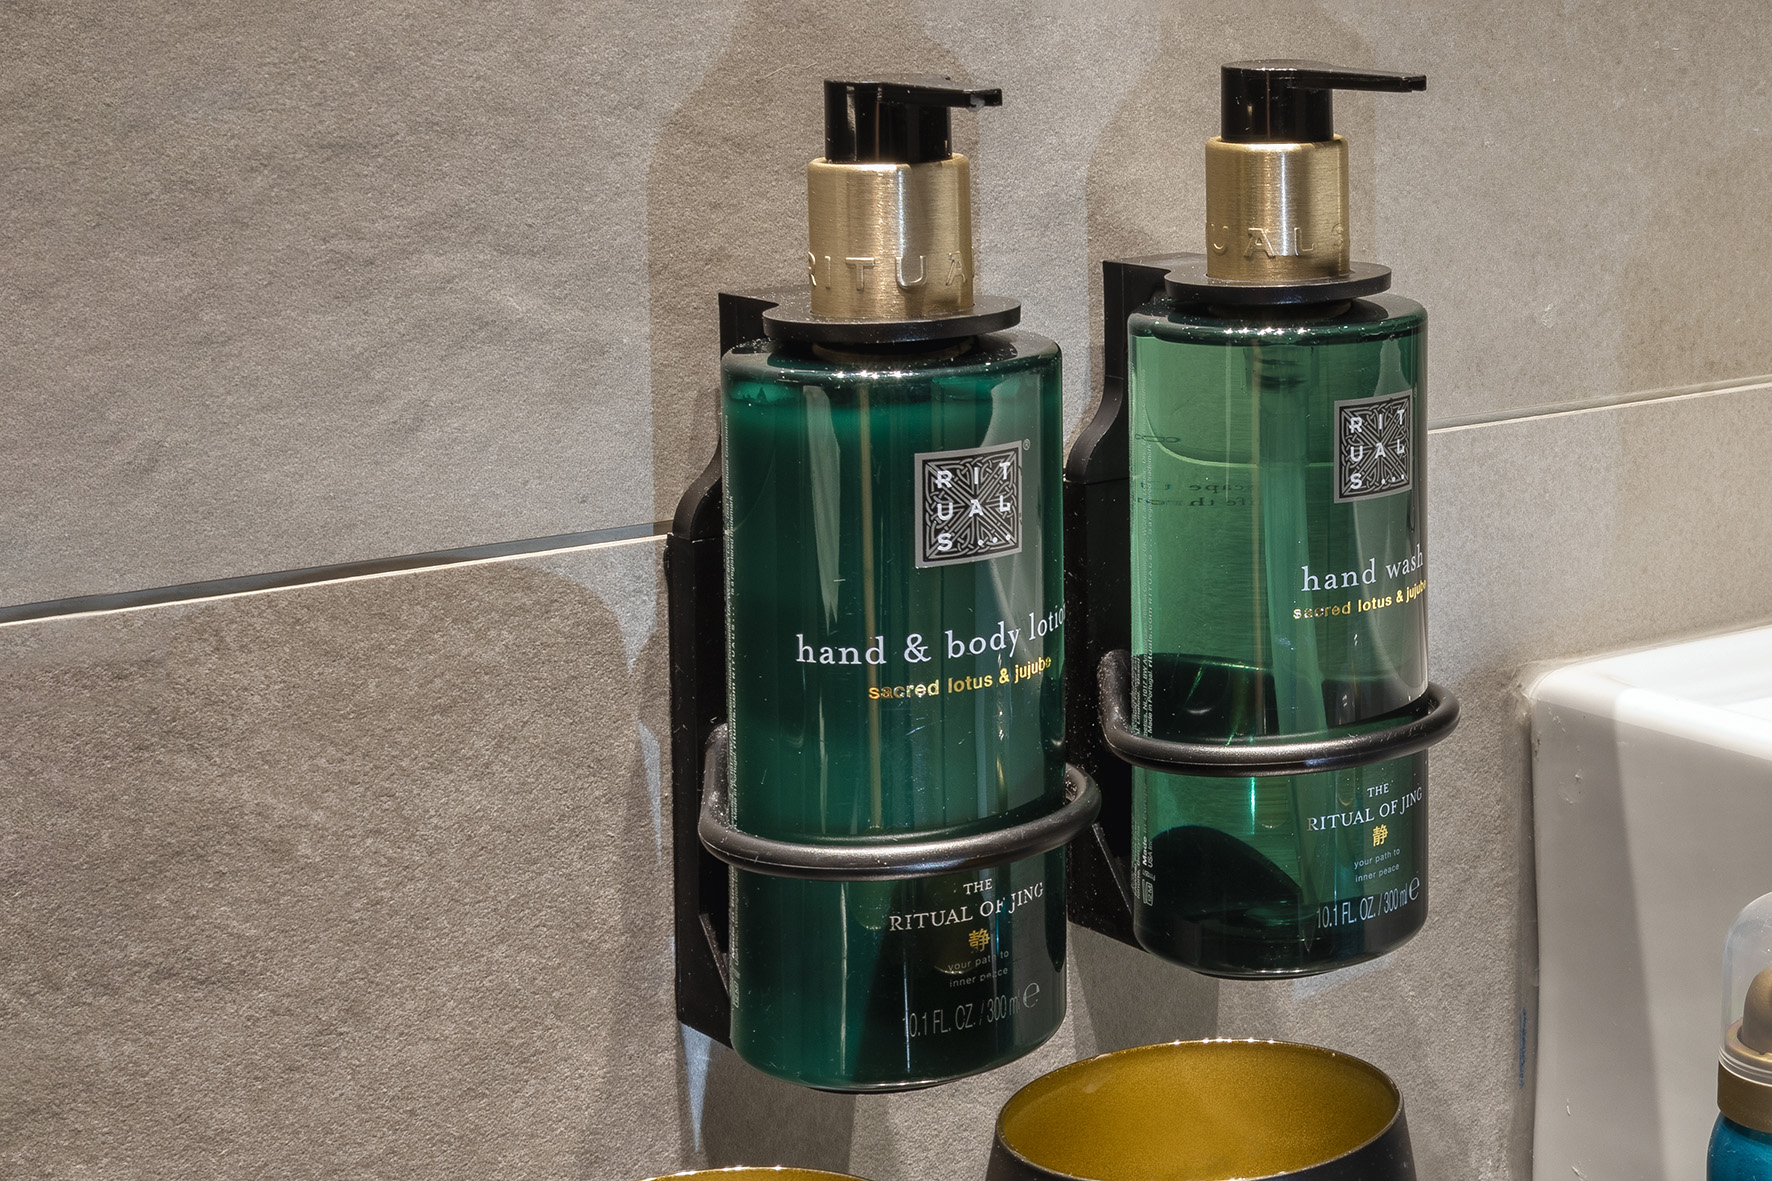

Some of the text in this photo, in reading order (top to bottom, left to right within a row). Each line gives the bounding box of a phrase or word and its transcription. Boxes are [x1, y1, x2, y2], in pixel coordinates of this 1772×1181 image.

[1301, 543, 1424, 592] hand wash
[1293, 601, 1351, 620] sacred
[1358, 595, 1392, 613] lotus
[1396, 589, 1404, 603] &
[796, 603, 1066, 665] hand & body lotio
[868, 656, 1052, 700] sacred lotus & jujube
[1307, 786, 1422, 832] RITUAL OF JING
[1367, 783, 1389, 798] THE
[1354, 848, 1401, 870] your path to
[1355, 863, 1400, 883] inner peace
[889, 882, 1044, 931] RITUAL OF JING
[963, 878, 993, 895] THE
[1316, 905, 1338, 929] 10.1
[1383, 888, 1400, 914] 300
[949, 976, 977, 988] inner
[902, 1012, 928, 1038] 0.1
[986, 995, 1007, 1023] 300
